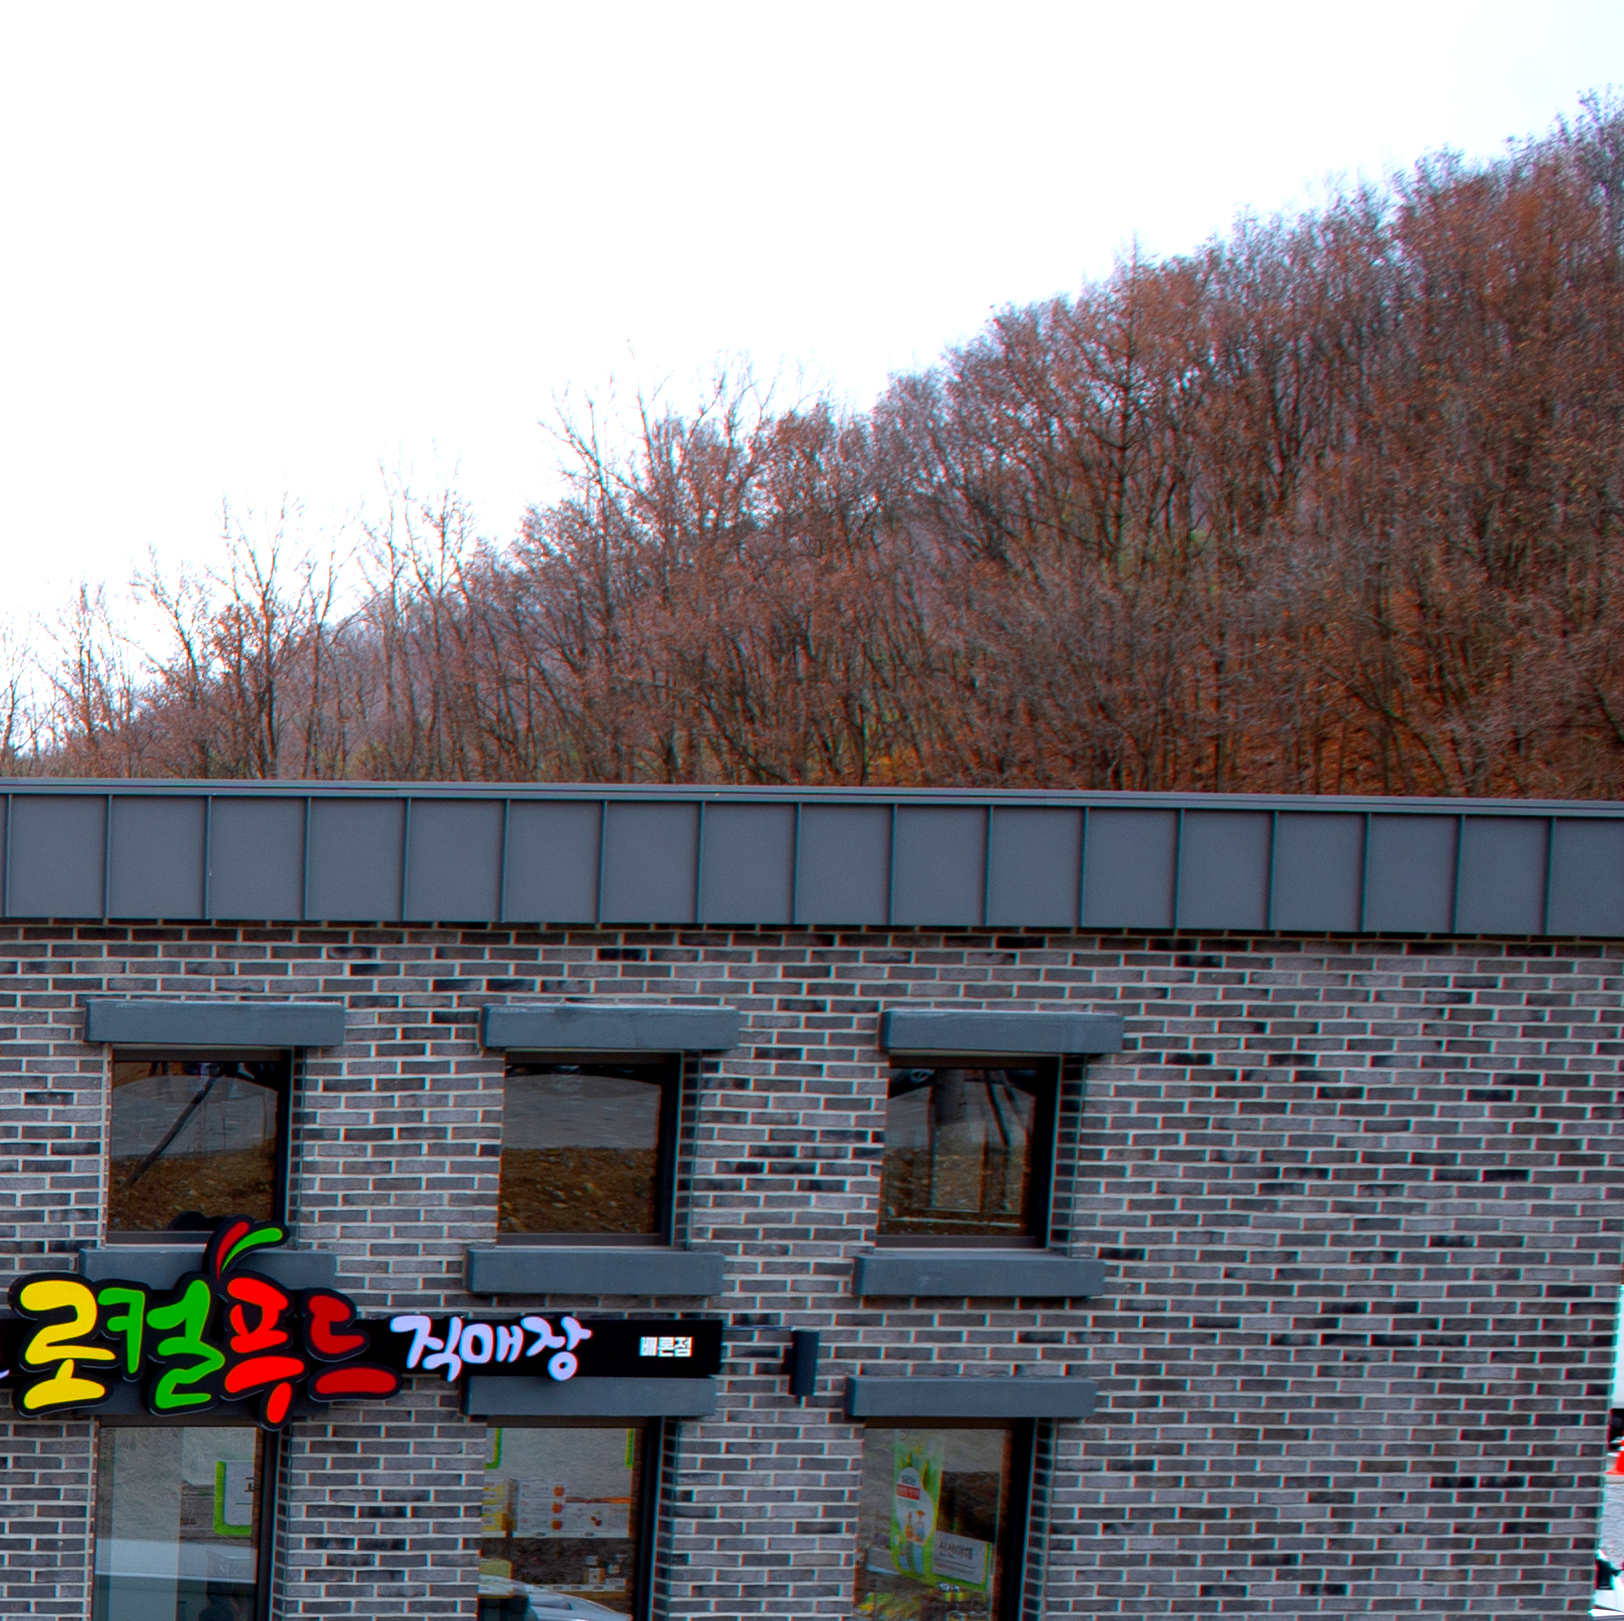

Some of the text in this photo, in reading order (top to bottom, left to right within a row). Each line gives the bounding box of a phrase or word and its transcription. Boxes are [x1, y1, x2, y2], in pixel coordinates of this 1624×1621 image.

[20, 1276, 398, 1425] 로컬푸드
[390, 1315, 593, 1382] 직매장
[639, 1335, 694, 1357] 배론점
